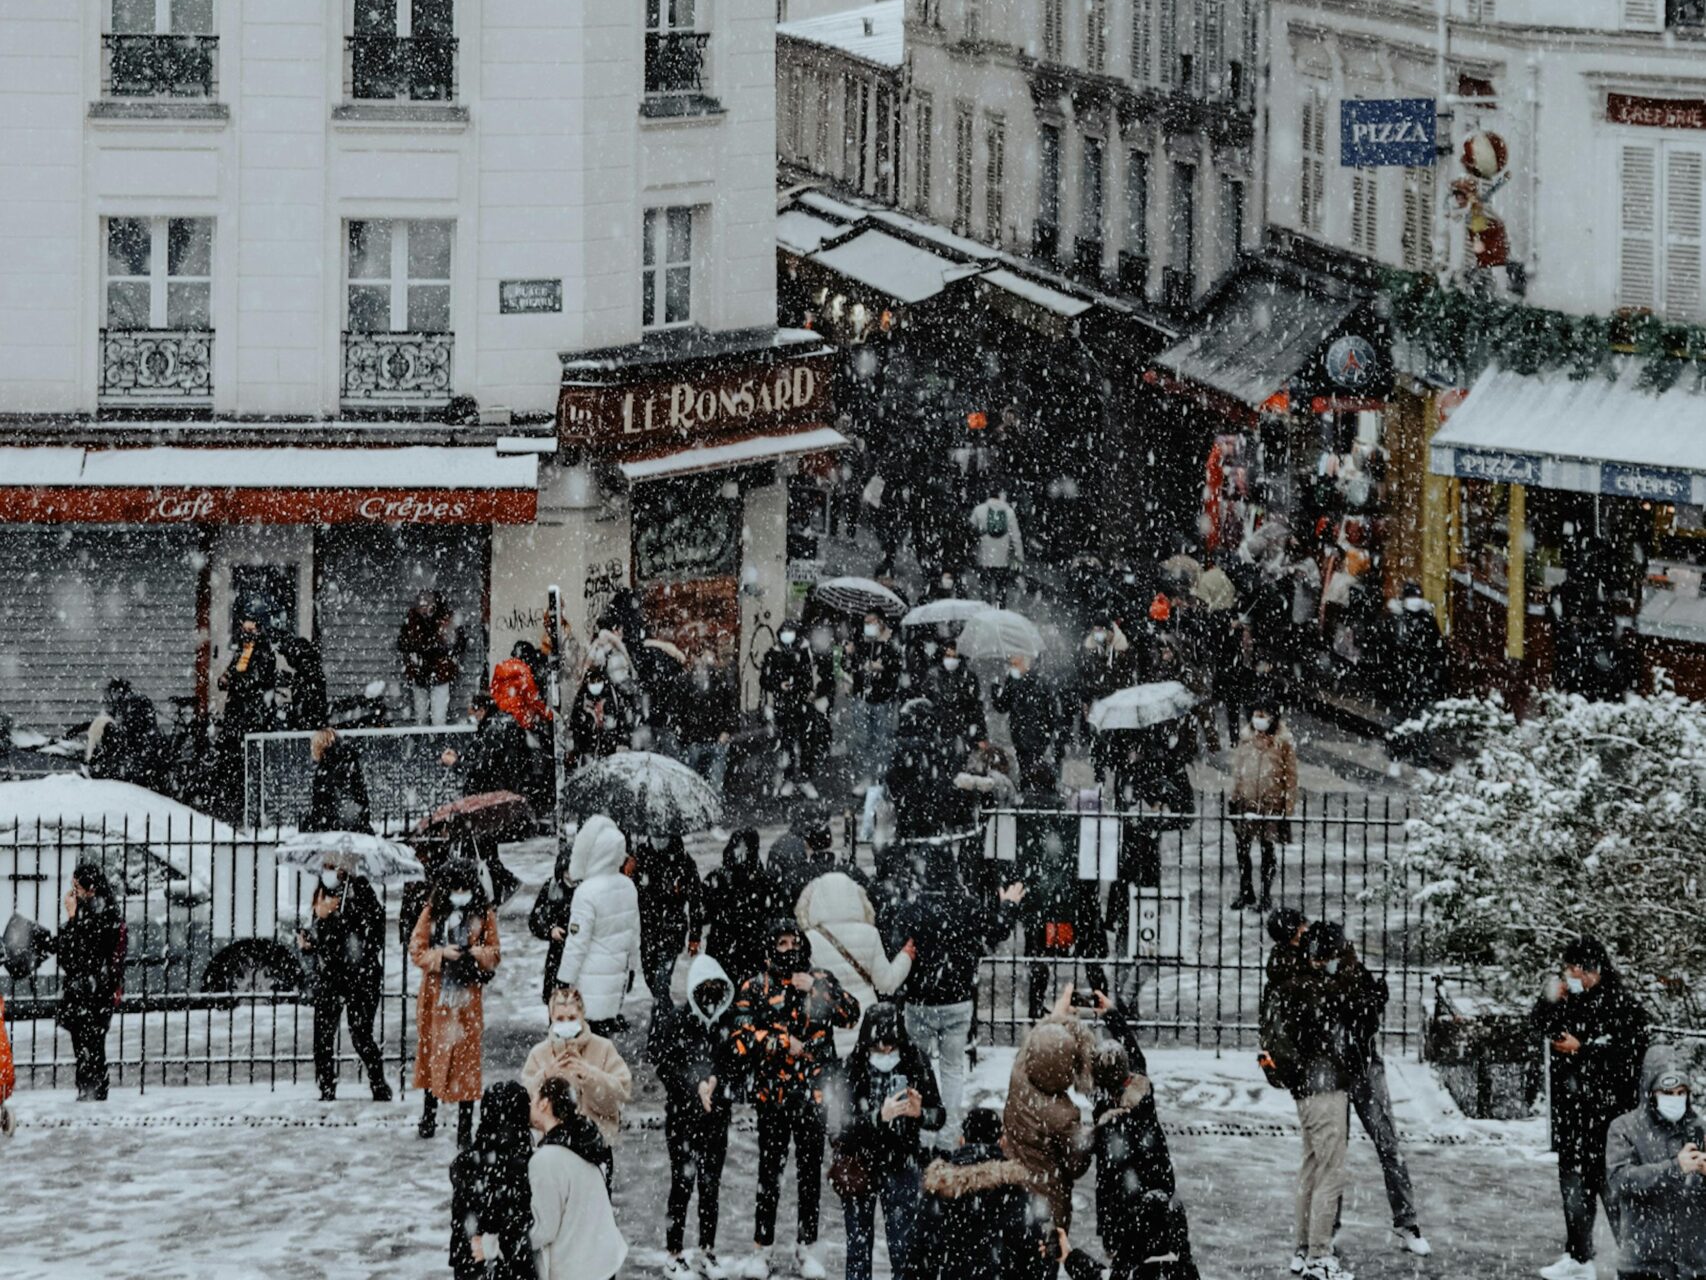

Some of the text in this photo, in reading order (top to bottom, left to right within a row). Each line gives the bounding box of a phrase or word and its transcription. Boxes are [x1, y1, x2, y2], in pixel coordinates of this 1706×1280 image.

[1352, 121, 1428, 143] PIZZA
[623, 368, 815, 434] LE RONSARD
[1460, 453, 1533, 480] PIZZA
[158, 495, 465, 522] Café Crêpes
